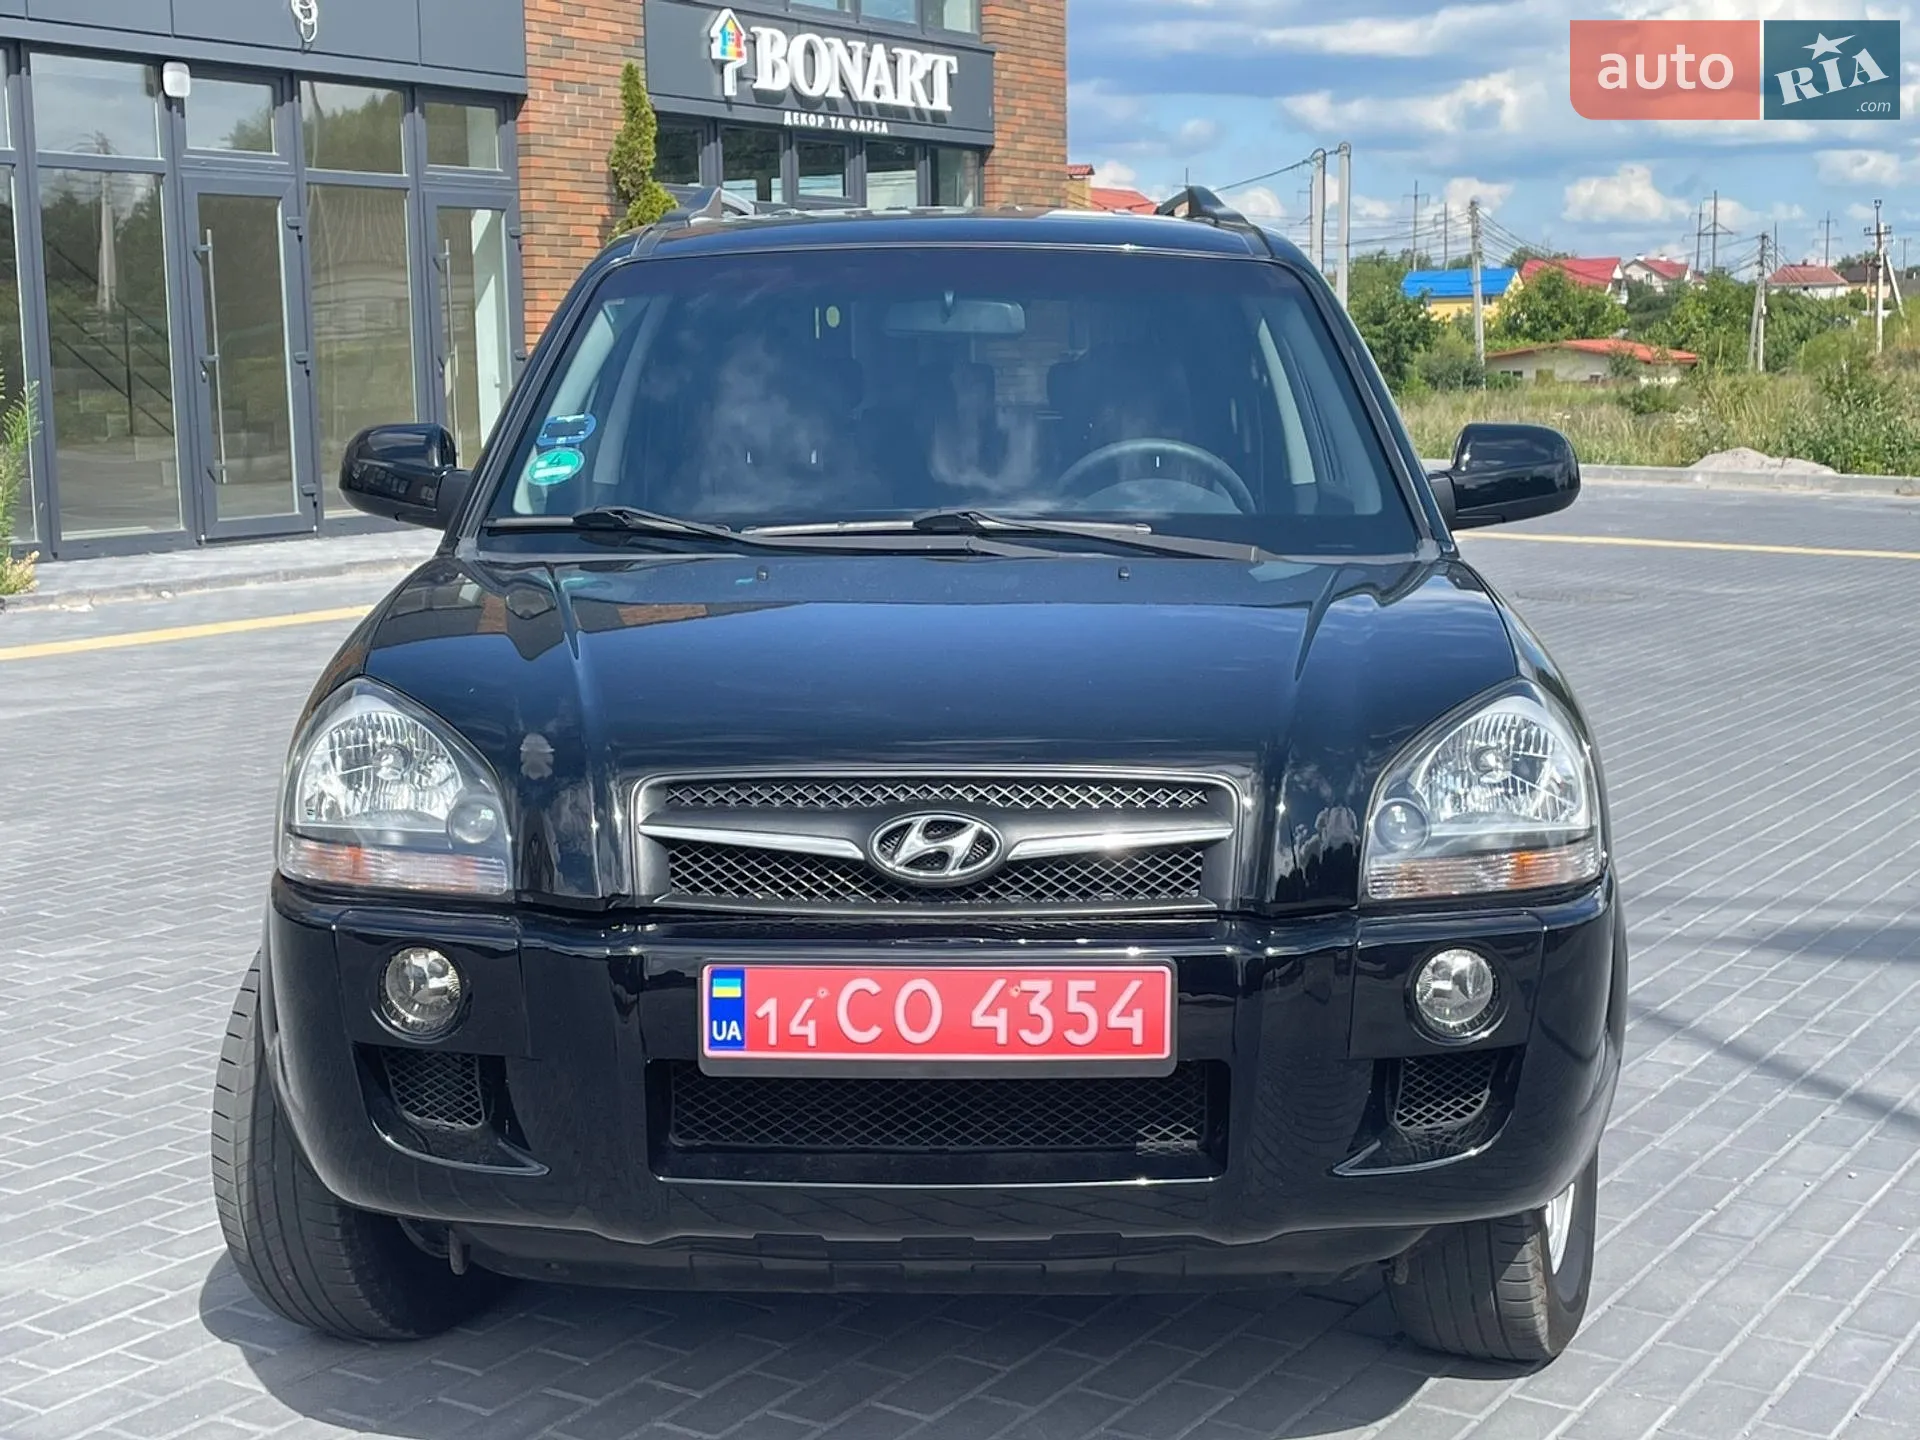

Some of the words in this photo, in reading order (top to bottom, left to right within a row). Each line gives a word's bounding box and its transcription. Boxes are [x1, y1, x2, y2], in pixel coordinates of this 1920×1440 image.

[750, 26, 959, 112] BONART
[783, 110, 824, 129] ДЕКОР
[829, 116, 845, 130] ТА
[849, 118, 889, 135] ФАРБА
[712, 1020, 742, 1041] UA
[755, 997, 817, 1048] 14
[836, 978, 943, 1045] CO
[971, 979, 1144, 1046] 4354
